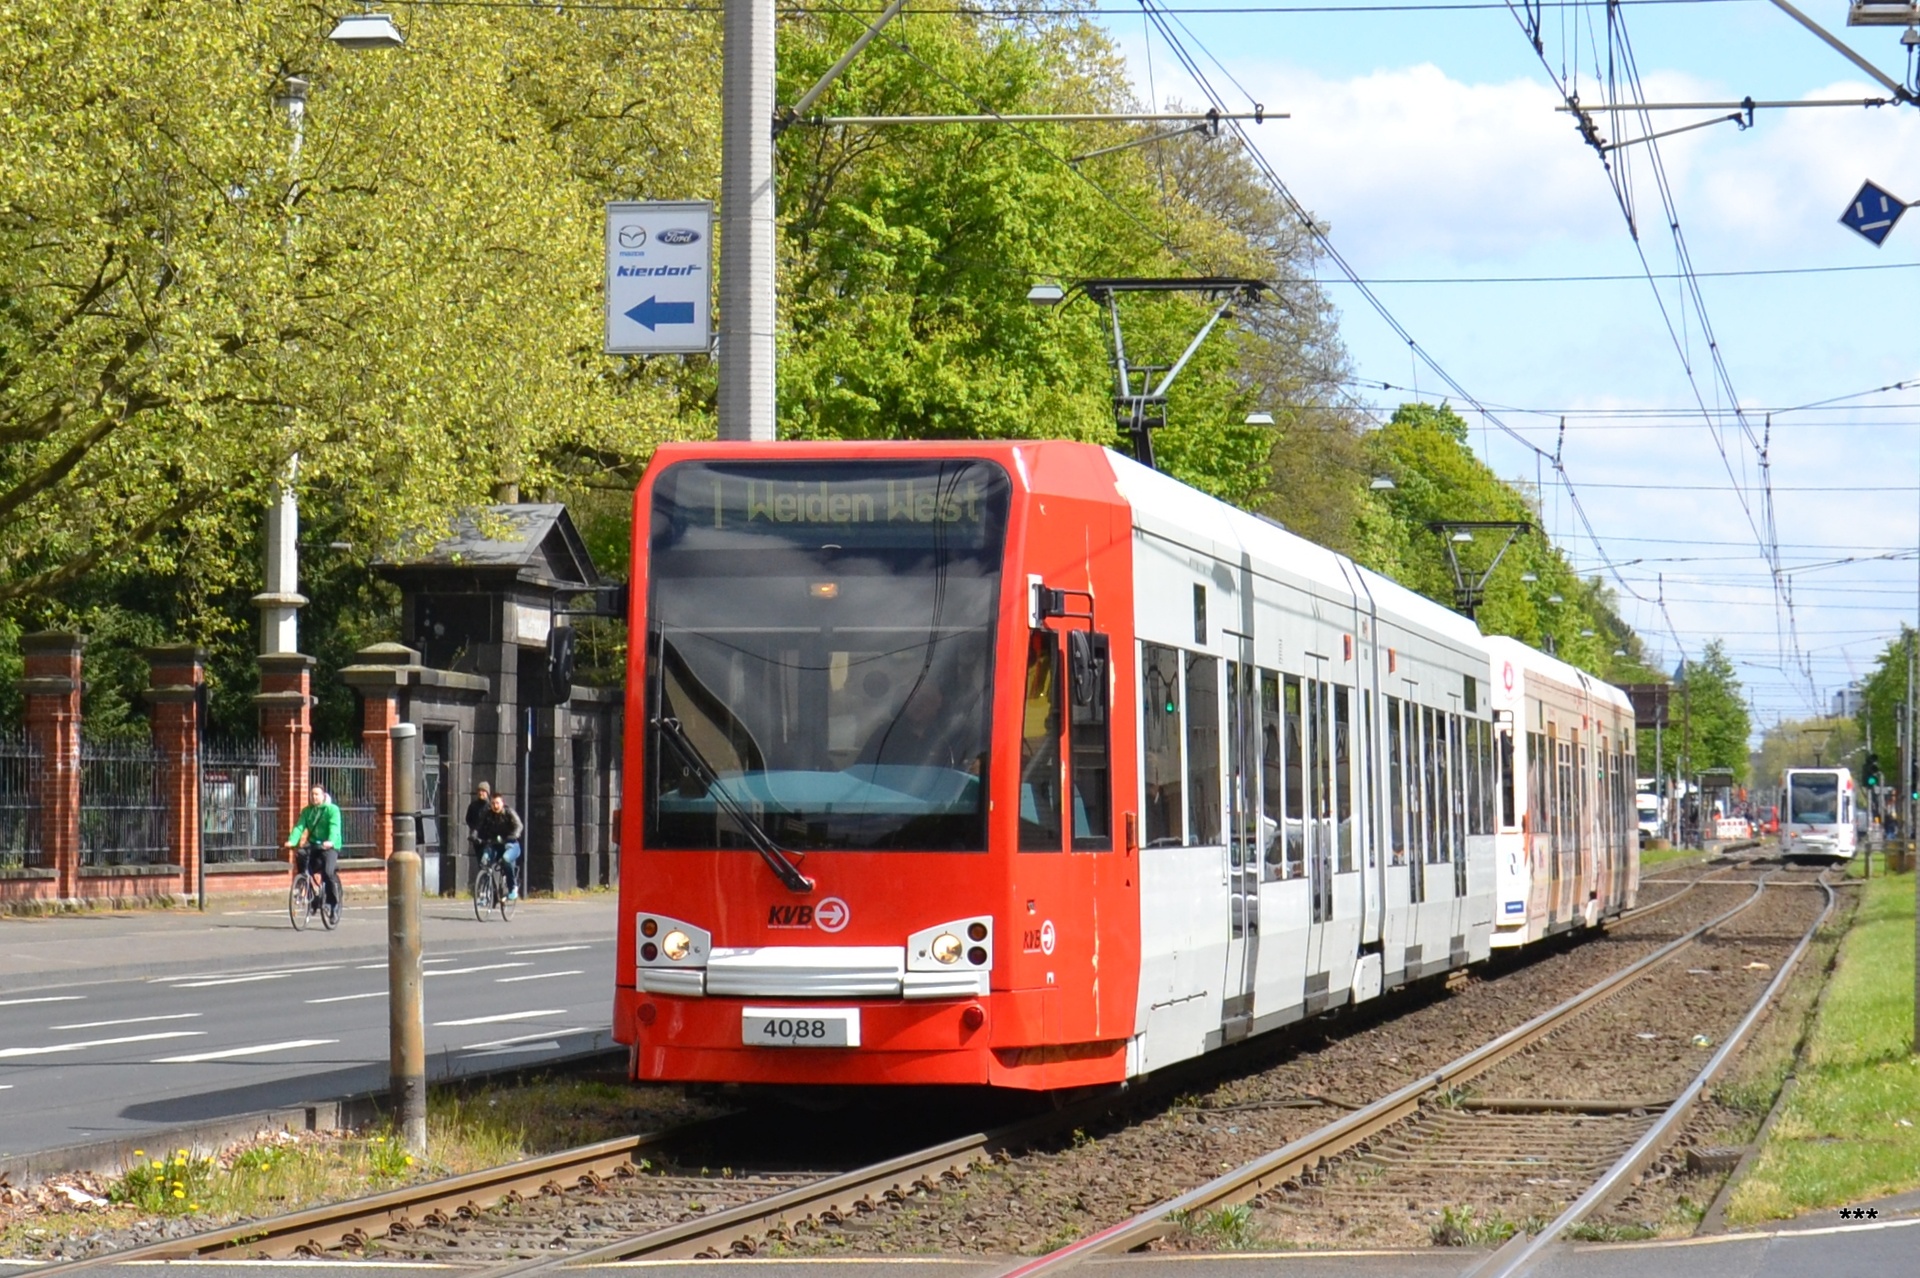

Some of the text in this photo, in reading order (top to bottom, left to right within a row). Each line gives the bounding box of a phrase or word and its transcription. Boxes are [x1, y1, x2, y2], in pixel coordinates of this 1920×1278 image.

[664, 230, 692, 243] Ford
[711, 480, 980, 529] 1 Weiden West
[768, 904, 814, 925] KVB
[1023, 929, 1041, 949] KVB
[763, 1019, 826, 1039] 4088
